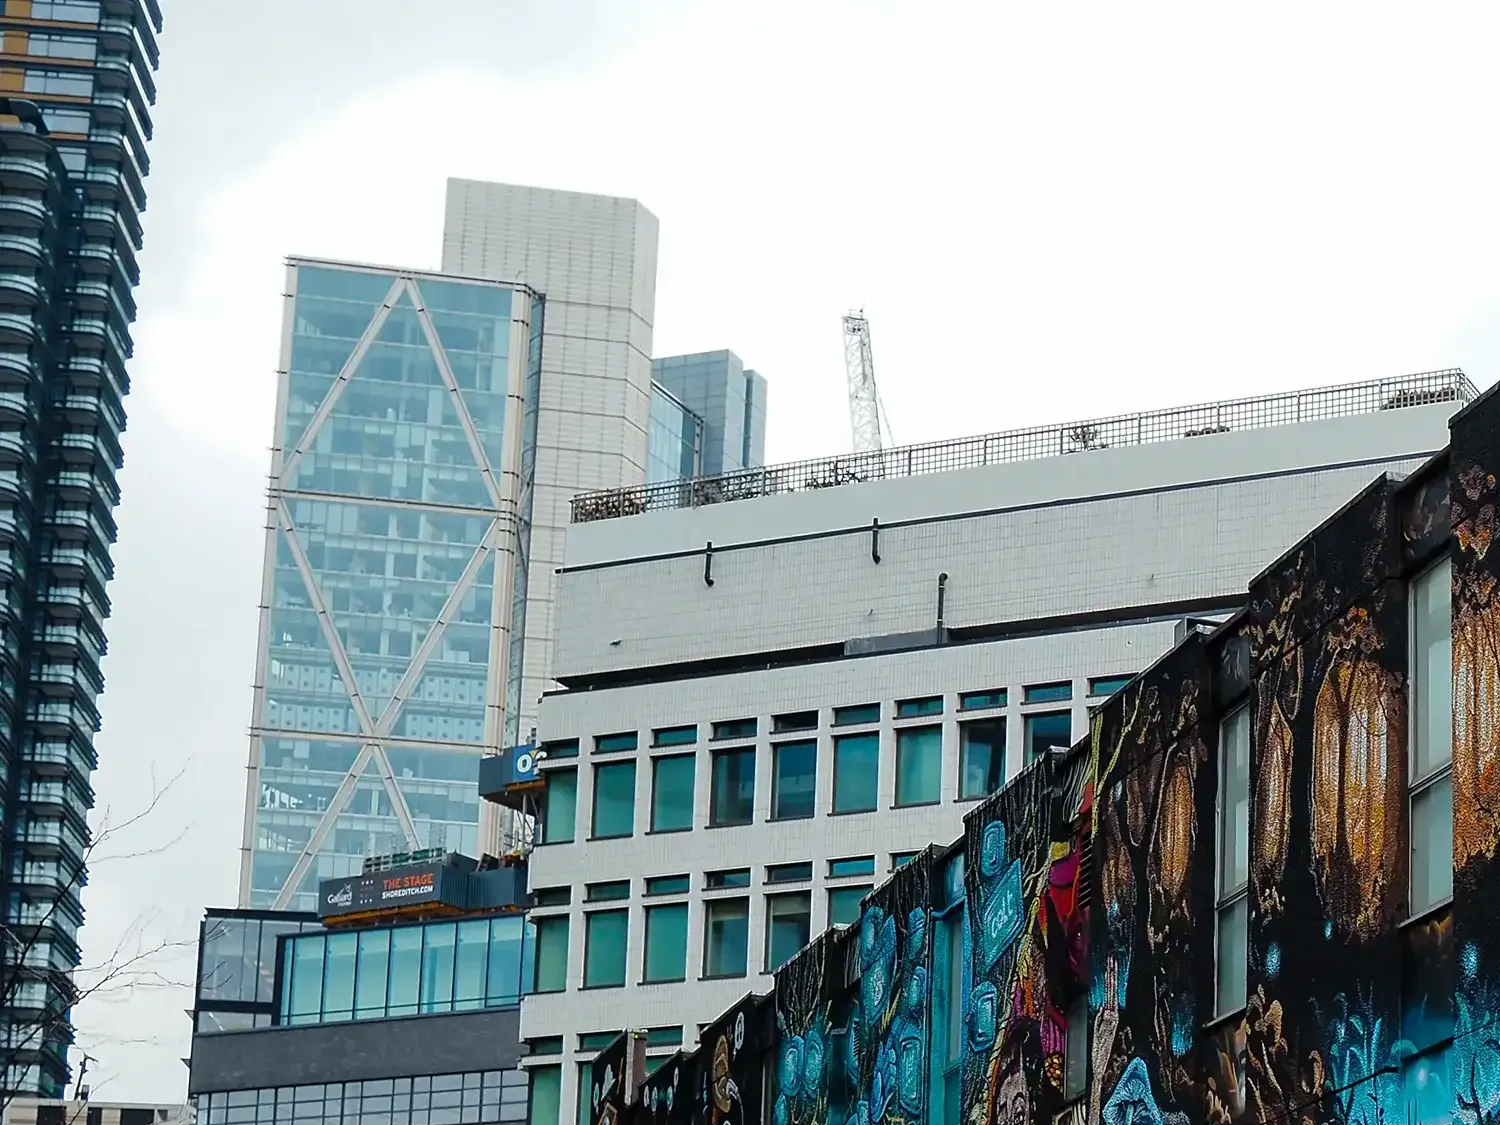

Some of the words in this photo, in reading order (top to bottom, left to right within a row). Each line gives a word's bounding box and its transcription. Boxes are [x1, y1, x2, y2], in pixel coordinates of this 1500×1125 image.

[383, 878, 402, 890] THE
[404, 873, 434, 887] STAGE
[382, 885, 434, 899] SHOREDITCH.COM
